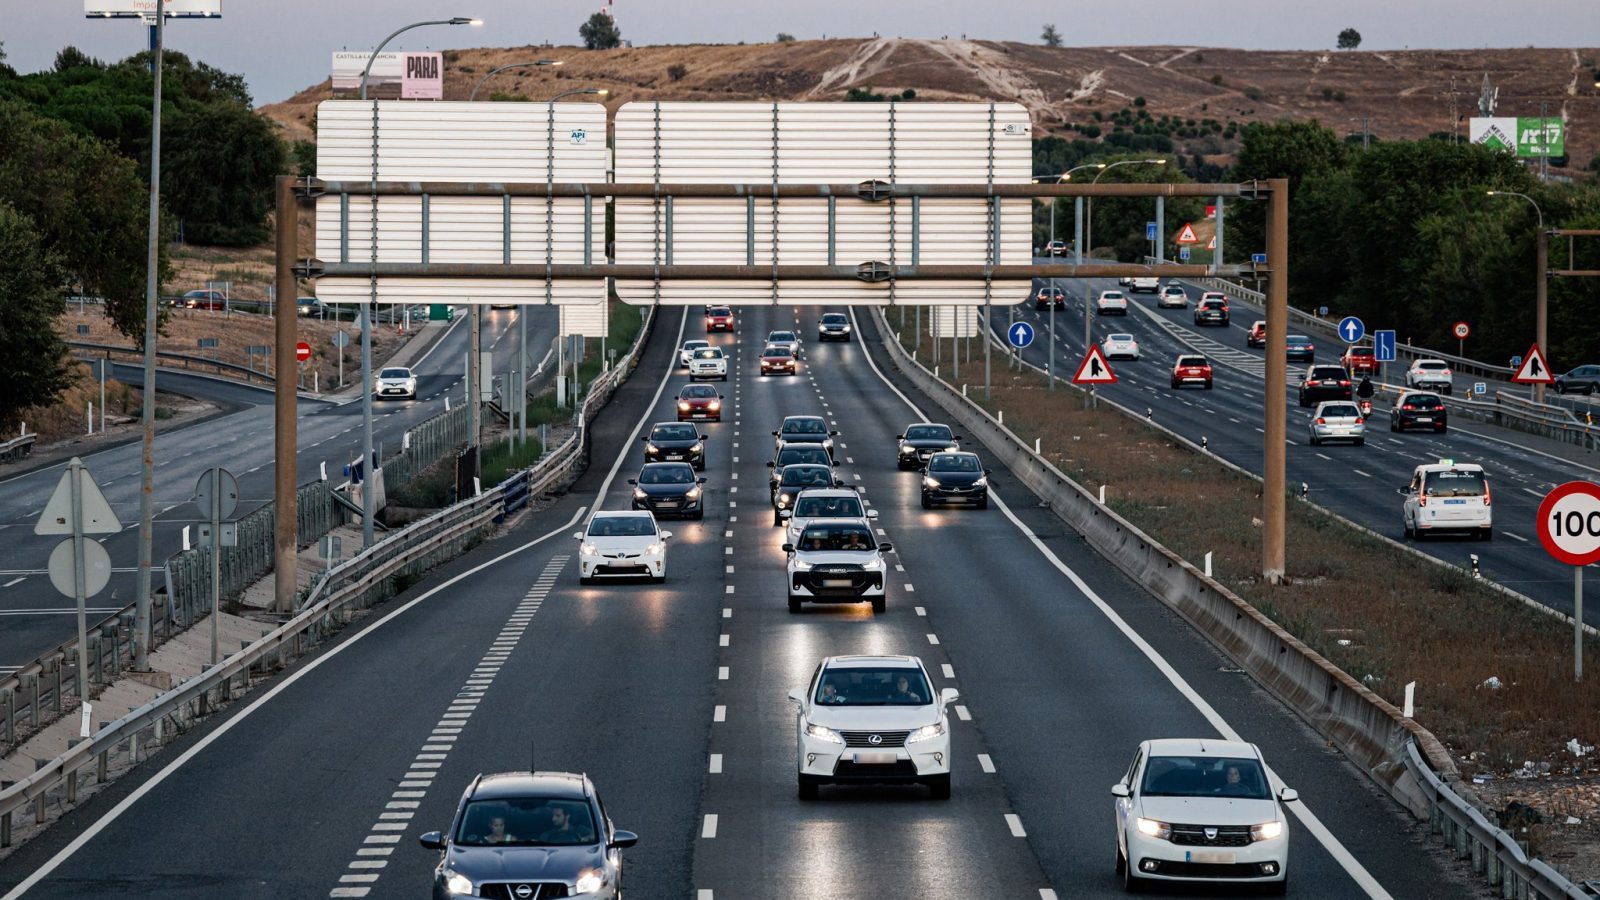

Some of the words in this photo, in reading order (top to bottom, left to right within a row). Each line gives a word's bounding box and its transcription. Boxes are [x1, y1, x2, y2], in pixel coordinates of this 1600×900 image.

[407, 56, 438, 78] PARA
[1542, 129, 1561, 144] 17
[1553, 511, 1600, 537] 100
